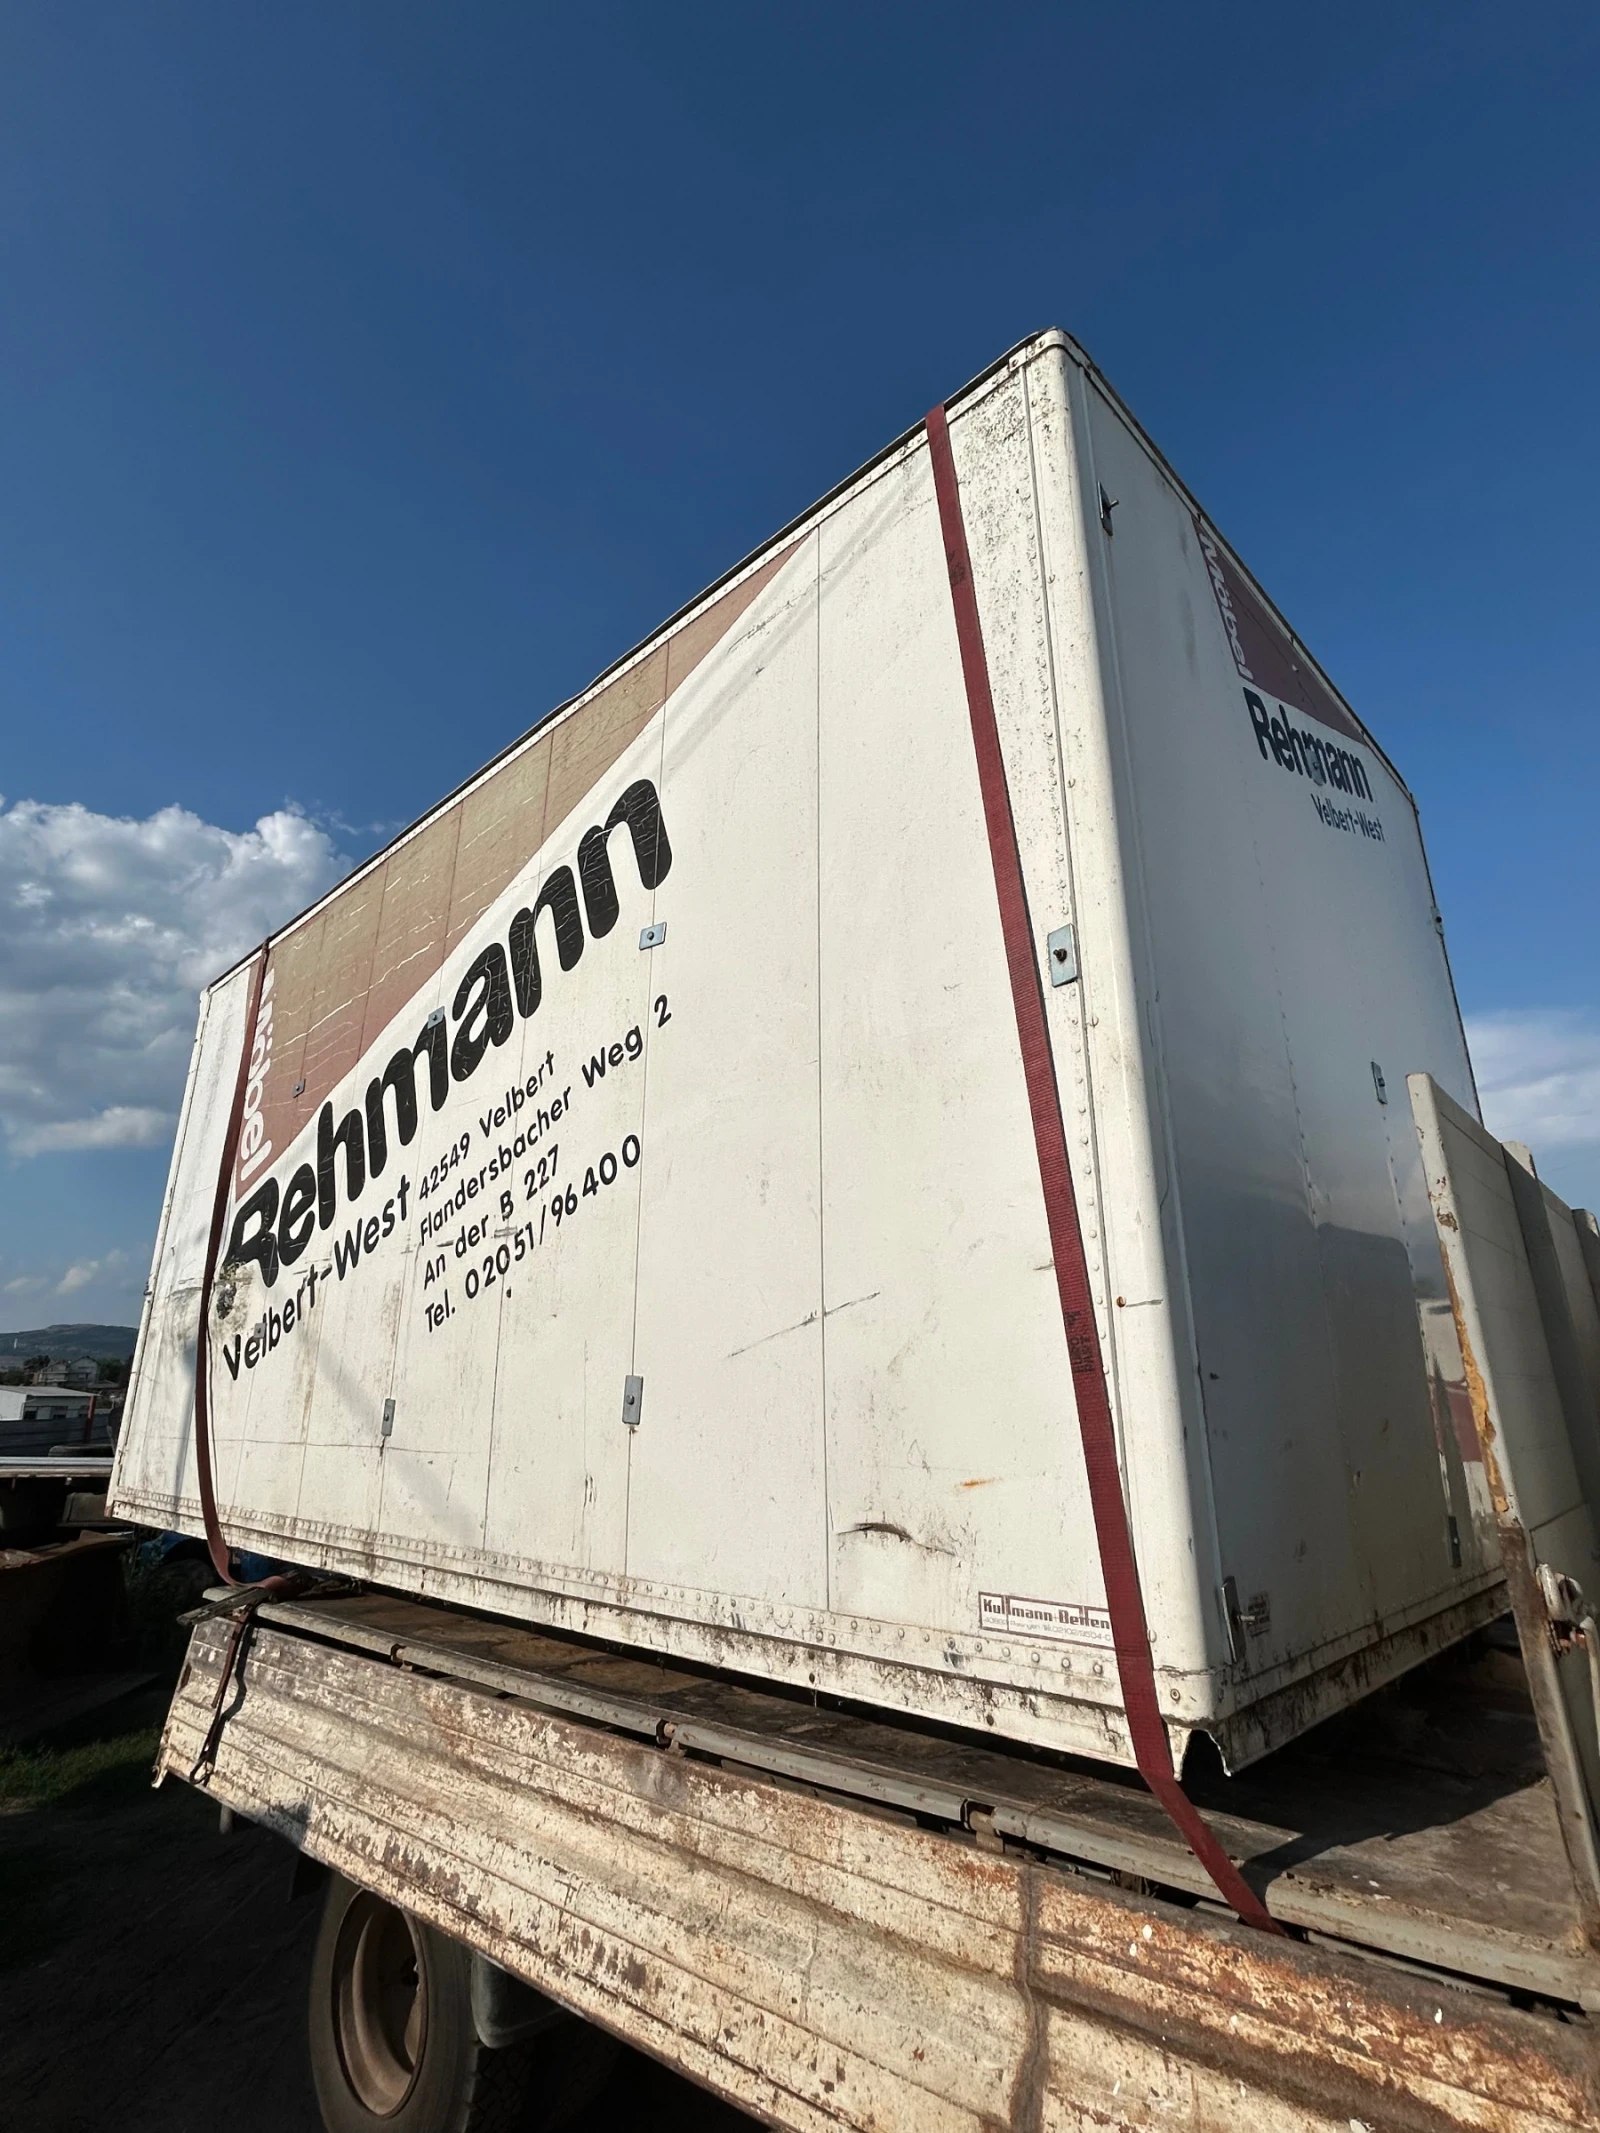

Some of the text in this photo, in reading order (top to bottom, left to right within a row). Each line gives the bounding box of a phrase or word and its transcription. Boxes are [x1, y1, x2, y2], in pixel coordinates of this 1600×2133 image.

[1242, 686, 1374, 803] Rehmann
[1310, 793, 1386, 843] Velbert-West
[217, 779, 673, 1319] Rehmann
[420, 994, 673, 1246] Flandersbacher Weg 2
[419, 1050, 555, 1200] 42549 Velbert
[223, 1174, 411, 1381] Velbert-West
[424, 1143, 560, 1290] An der B 227
[424, 1289, 456, 1333] Tel.
